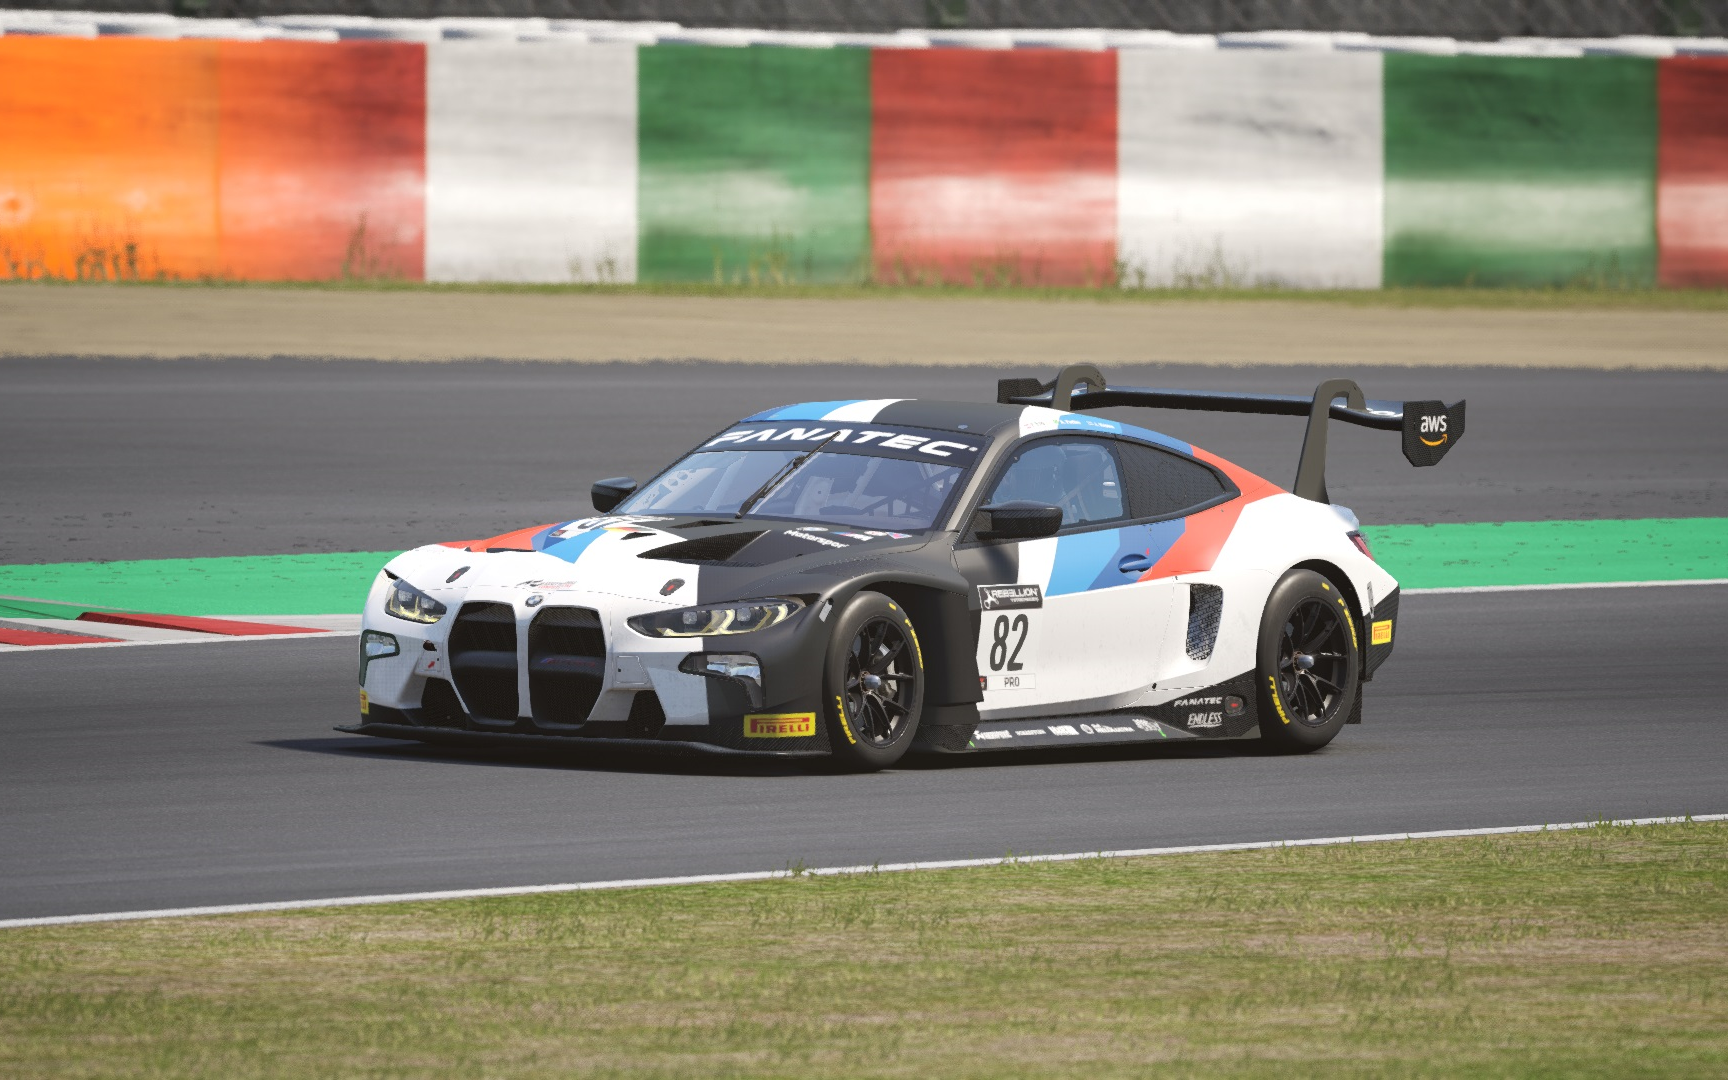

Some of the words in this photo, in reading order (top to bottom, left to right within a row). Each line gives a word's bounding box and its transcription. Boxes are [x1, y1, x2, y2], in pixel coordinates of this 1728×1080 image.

[1420, 414, 1448, 433] aws
[705, 427, 971, 457] FANATEC
[991, 587, 1039, 598] REBELLION
[989, 613, 1029, 672] 82
[1003, 676, 1020, 687] PRO
[1173, 696, 1223, 708] FANATEC
[750, 717, 811, 733] PIRELLI
[1187, 711, 1223, 727] ENDLESS
